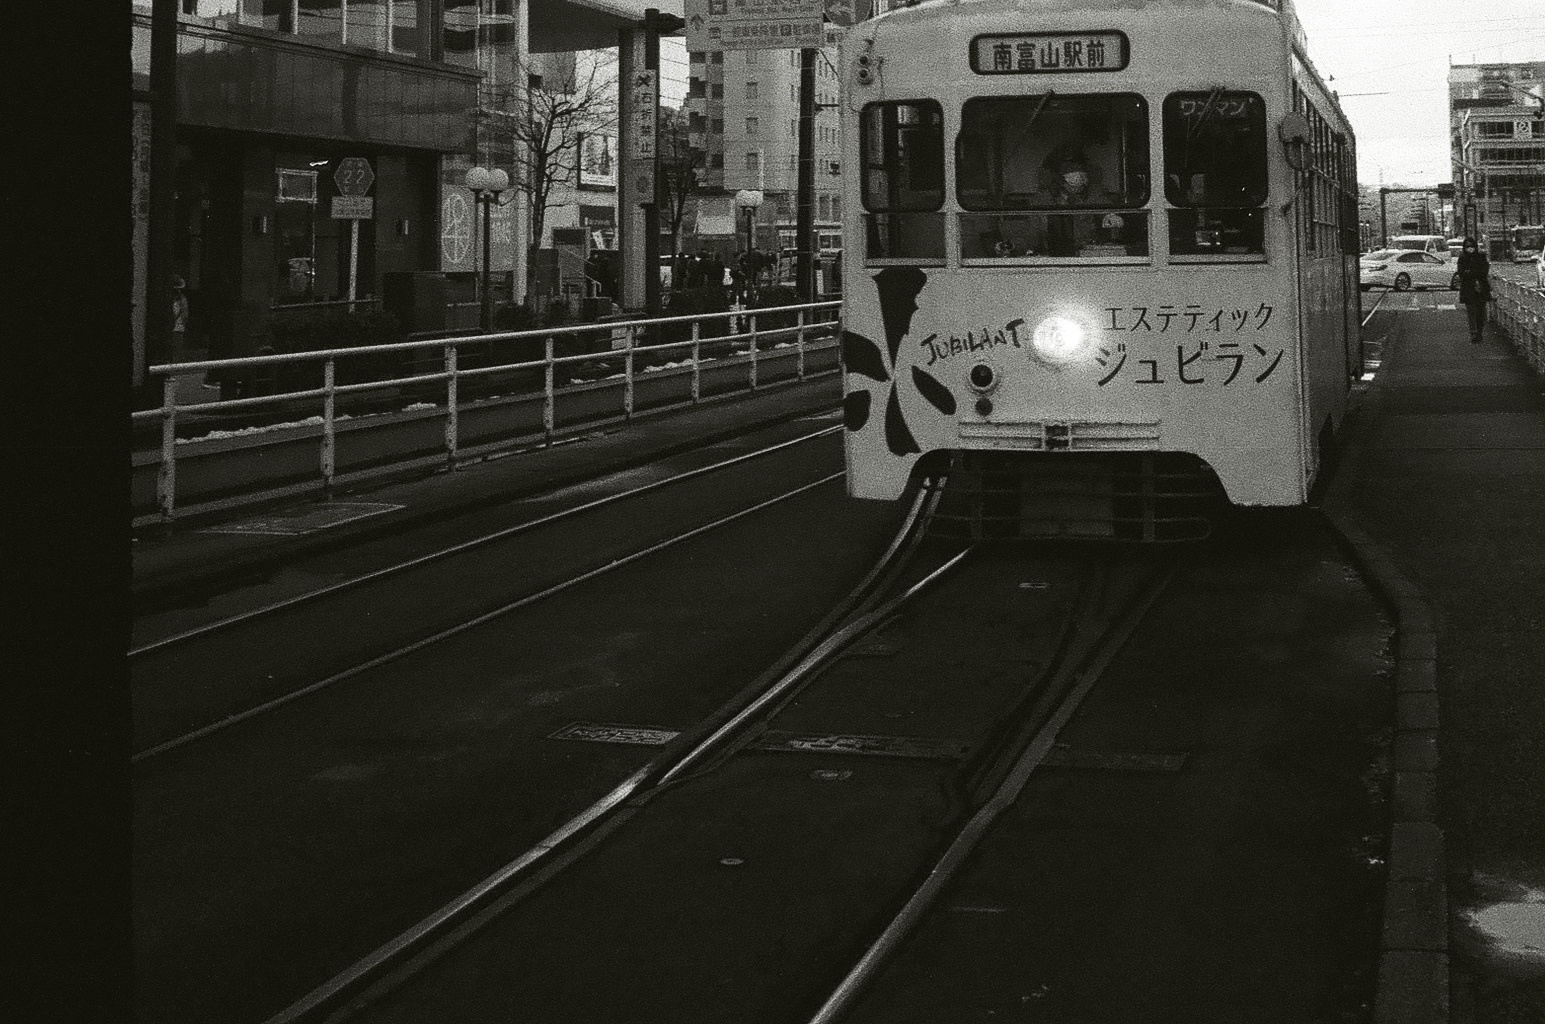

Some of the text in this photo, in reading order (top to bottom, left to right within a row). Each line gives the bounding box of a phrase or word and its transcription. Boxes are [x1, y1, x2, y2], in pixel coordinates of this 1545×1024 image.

[992, 39, 1106, 70] 南富山駅前
[1180, 100, 1247, 116] ワンマン
[344, 169, 365, 184] 22
[1103, 302, 1274, 333] エステティック
[1095, 340, 1285, 387] ジュビラン
